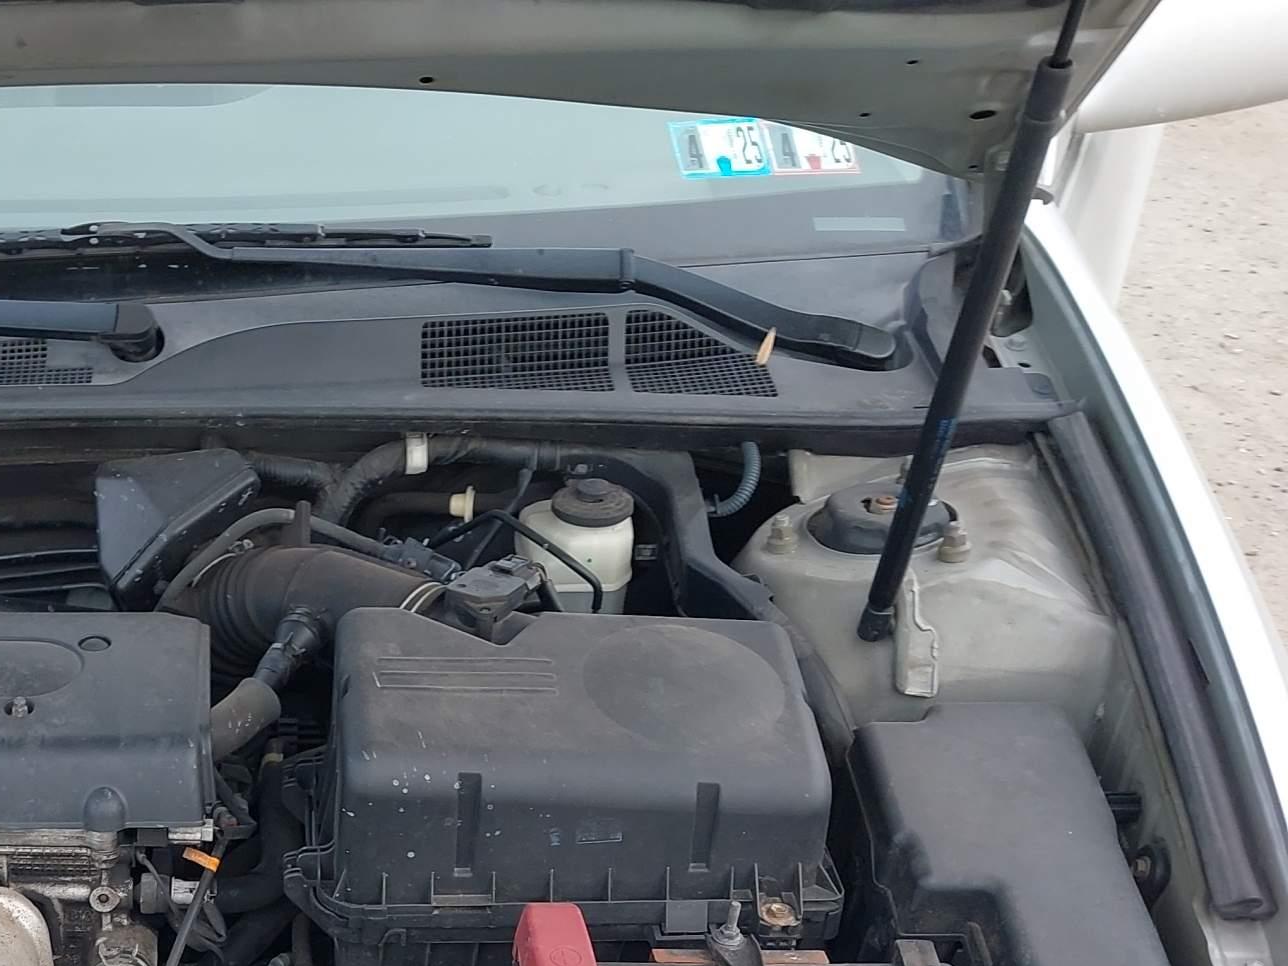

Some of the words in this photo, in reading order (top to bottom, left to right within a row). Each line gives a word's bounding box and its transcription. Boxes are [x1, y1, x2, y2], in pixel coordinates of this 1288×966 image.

[688, 134, 704, 169] 4
[736, 126, 764, 164] 25
[780, 133, 798, 168] 4
